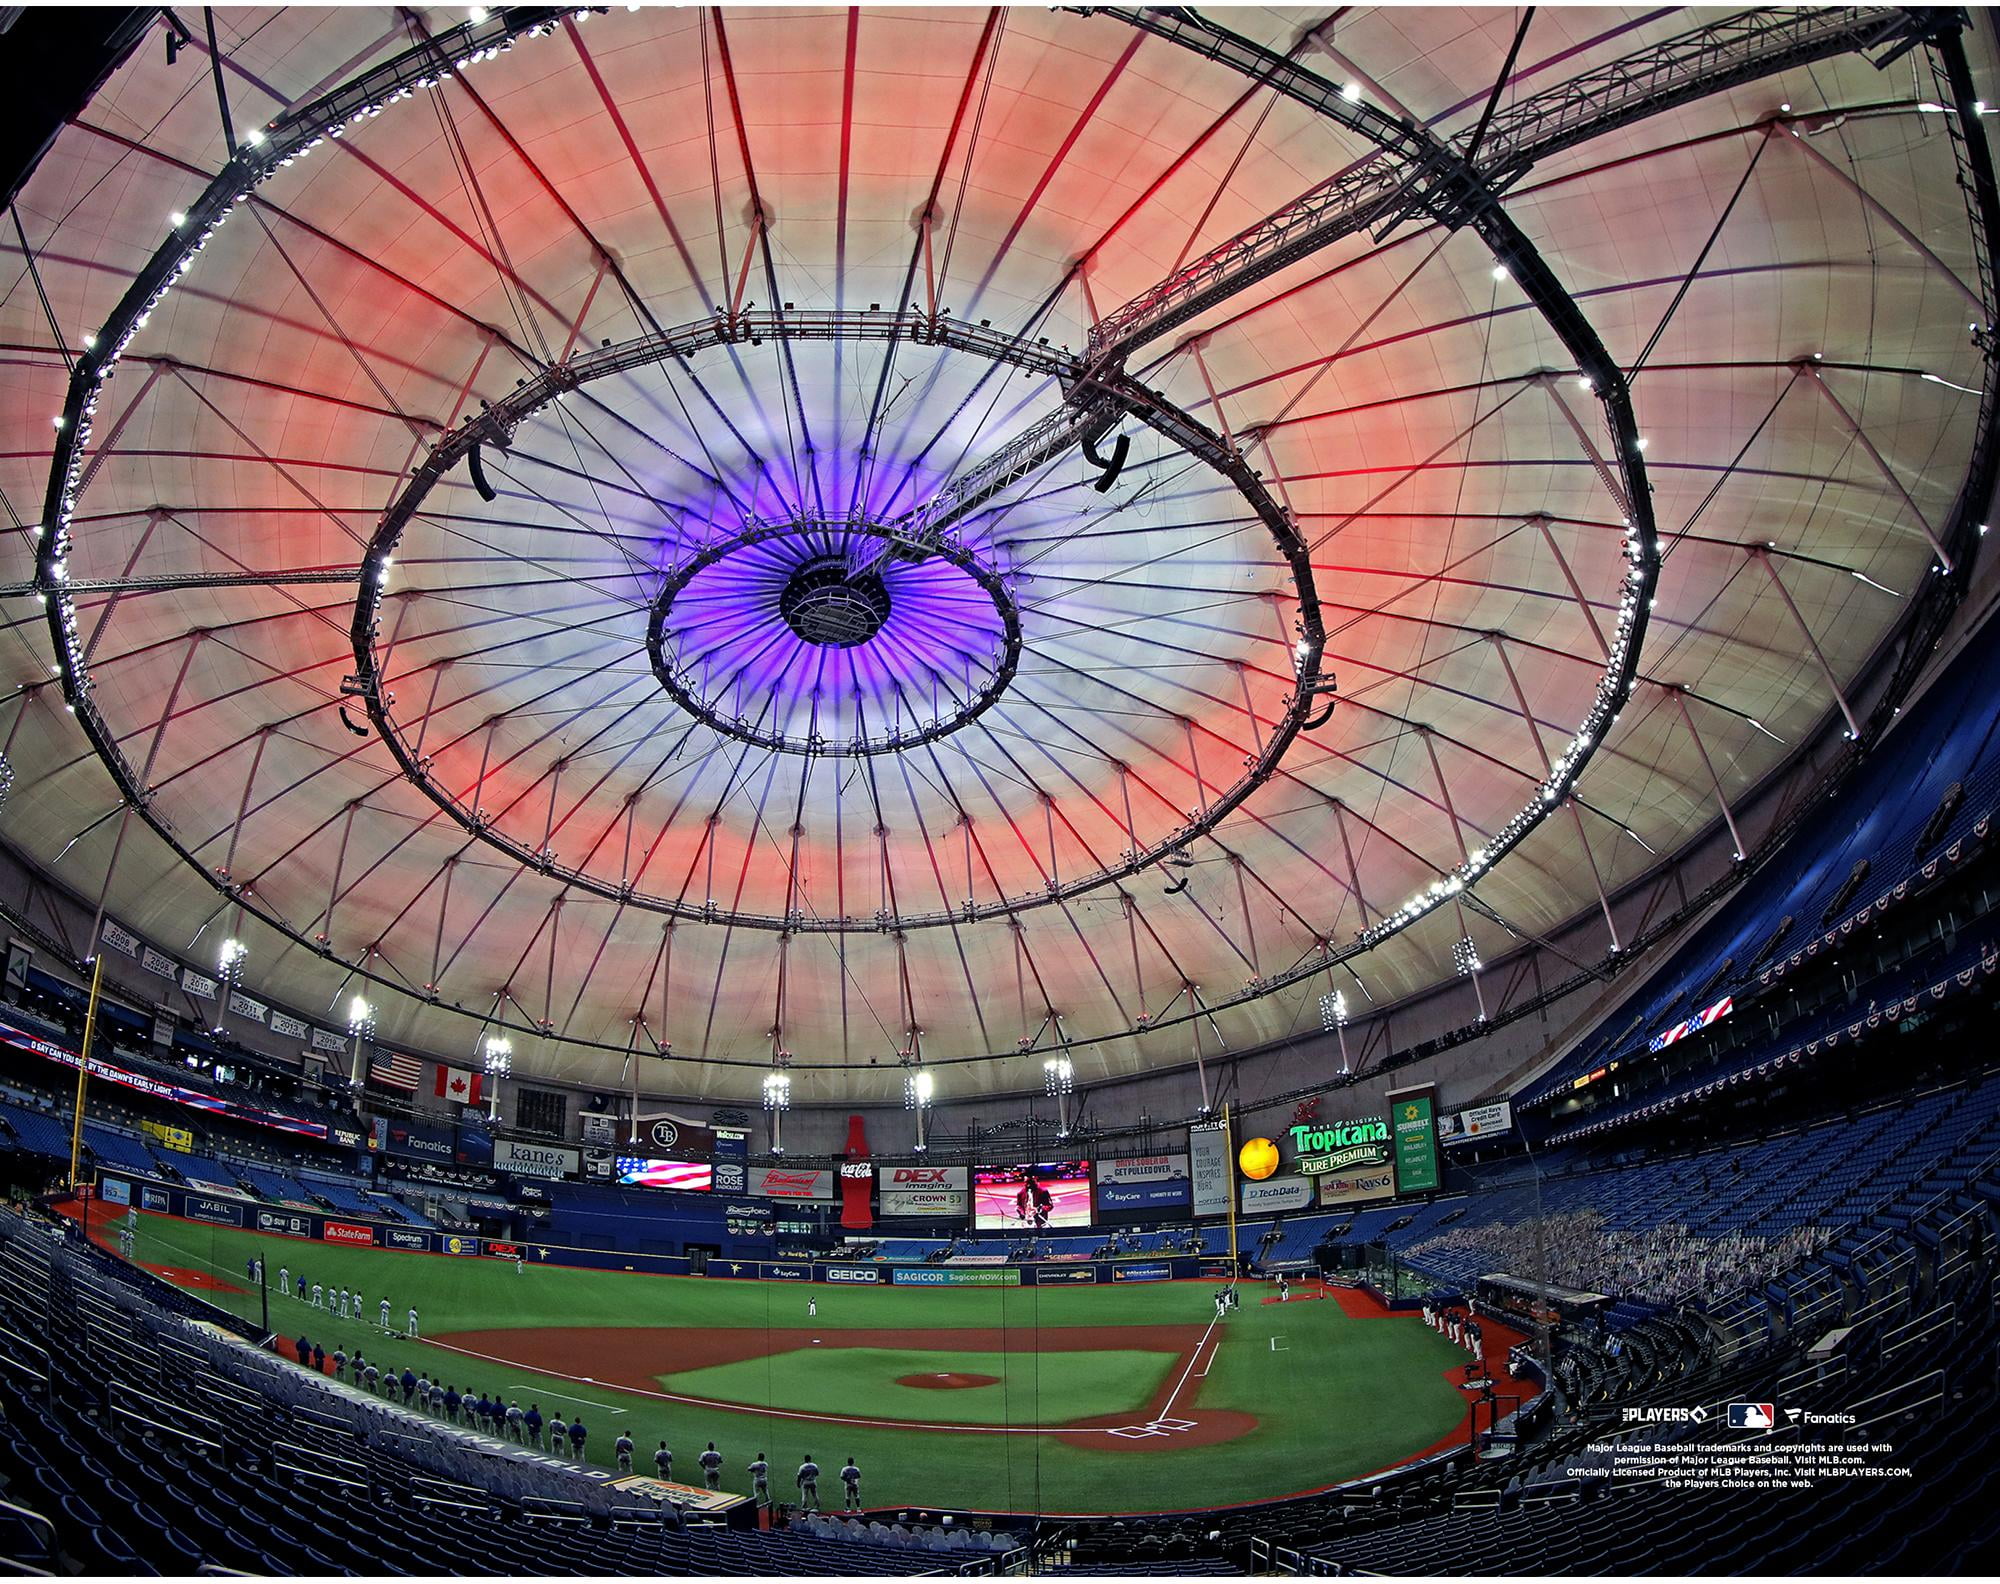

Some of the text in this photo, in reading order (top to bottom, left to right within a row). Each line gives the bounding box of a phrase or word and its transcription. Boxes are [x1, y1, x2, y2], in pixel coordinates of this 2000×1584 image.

[104, 934, 132, 955] CHAMPIONS
[110, 930, 130, 947] 2008
[144, 961, 173, 978] CHAMPIONS
[150, 956, 170, 971] 2008
[190, 978, 208, 991] 2010
[184, 984, 212, 998] CHAMPIONS
[238, 1001, 257, 1014] 2011
[280, 1020, 298, 1032] 2013
[320, 1036, 337, 1045] 2019
[36, 1043, 50, 1055] SAY
[49, 1048, 62, 1058] CAN
[62, 1052, 74, 1064] YOU
[88, 1062, 96, 1072] BY
[98, 1066, 108, 1076] THE
[110, 1070, 134, 1084] DAWN'S
[134, 1077, 154, 1090] EARLY
[154, 1084, 173, 1096] LIGHT,
[1469, 1106, 1501, 1118] Official Rays
[1488, 1112, 1500, 1120] Card
[1346, 1116, 1382, 1126] ORIGINAL
[1397, 1118, 1428, 1131] SUNBELT
[334, 1129, 360, 1141] REPUBLIC
[657, 1125, 674, 1142] TB
[1290, 1122, 1388, 1152] Tropicana
[340, 1136, 356, 1144] BANK
[408, 1136, 452, 1154] Fanatics
[509, 1143, 565, 1166] kanes
[1194, 1146, 1210, 1156] YOUR
[1116, 1156, 1168, 1168] DRIVE SOBER OR
[1196, 1158, 1220, 1168] COURAGE
[1302, 1147, 1376, 1172] PURE PREMIUM
[894, 1169, 948, 1182] DEX
[1114, 1165, 1171, 1176] GET PULLED OVER
[1197, 1169, 1220, 1179] INSPIRES
[716, 1176, 744, 1186] ROSE
[905, 1182, 952, 1190] imaging
[1355, 1178, 1380, 1190] RAYS
[1382, 1175, 1391, 1186] 6
[1115, 1193, 1140, 1201] BayCare
[200, 1202, 230, 1214] JABIL
[274, 1218, 286, 1226] SUN
[392, 1232, 423, 1243] Spectrum
[488, 1242, 518, 1254] DEX
[829, 1270, 876, 1280] GEICO
[896, 1272, 1017, 1282] SAGICOR SagicorNOW.com
[512, 1451, 612, 1479] FIELD
[637, 1482, 710, 1501] Tropicana
